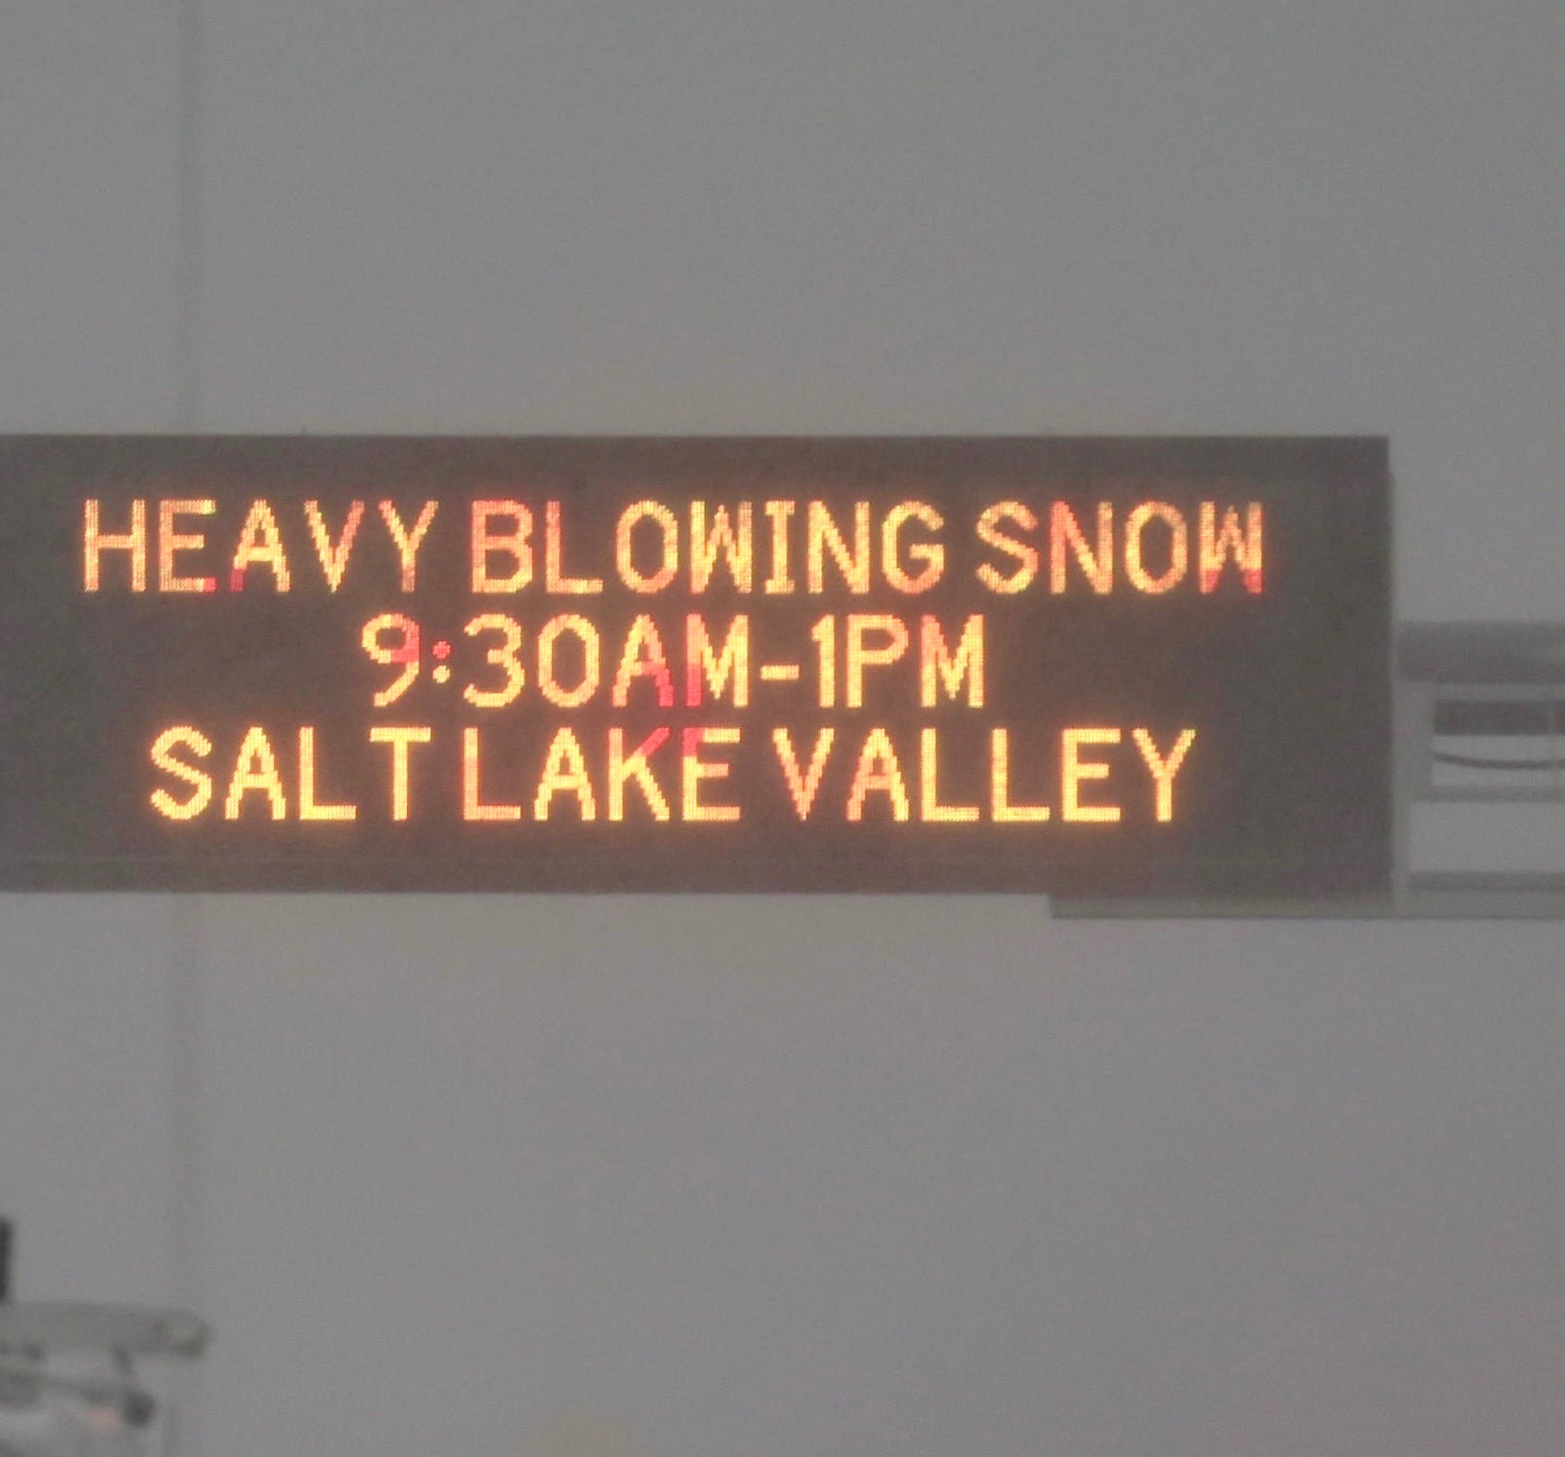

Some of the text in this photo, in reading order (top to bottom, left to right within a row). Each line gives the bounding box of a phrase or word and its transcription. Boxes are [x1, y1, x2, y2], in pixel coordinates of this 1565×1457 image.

[81, 498, 1264, 597] HEAVY BLOWING SNOW
[357, 611, 988, 711] 9:30AM-1PM
[146, 723, 1198, 824] SALT LAKE VALLEY
